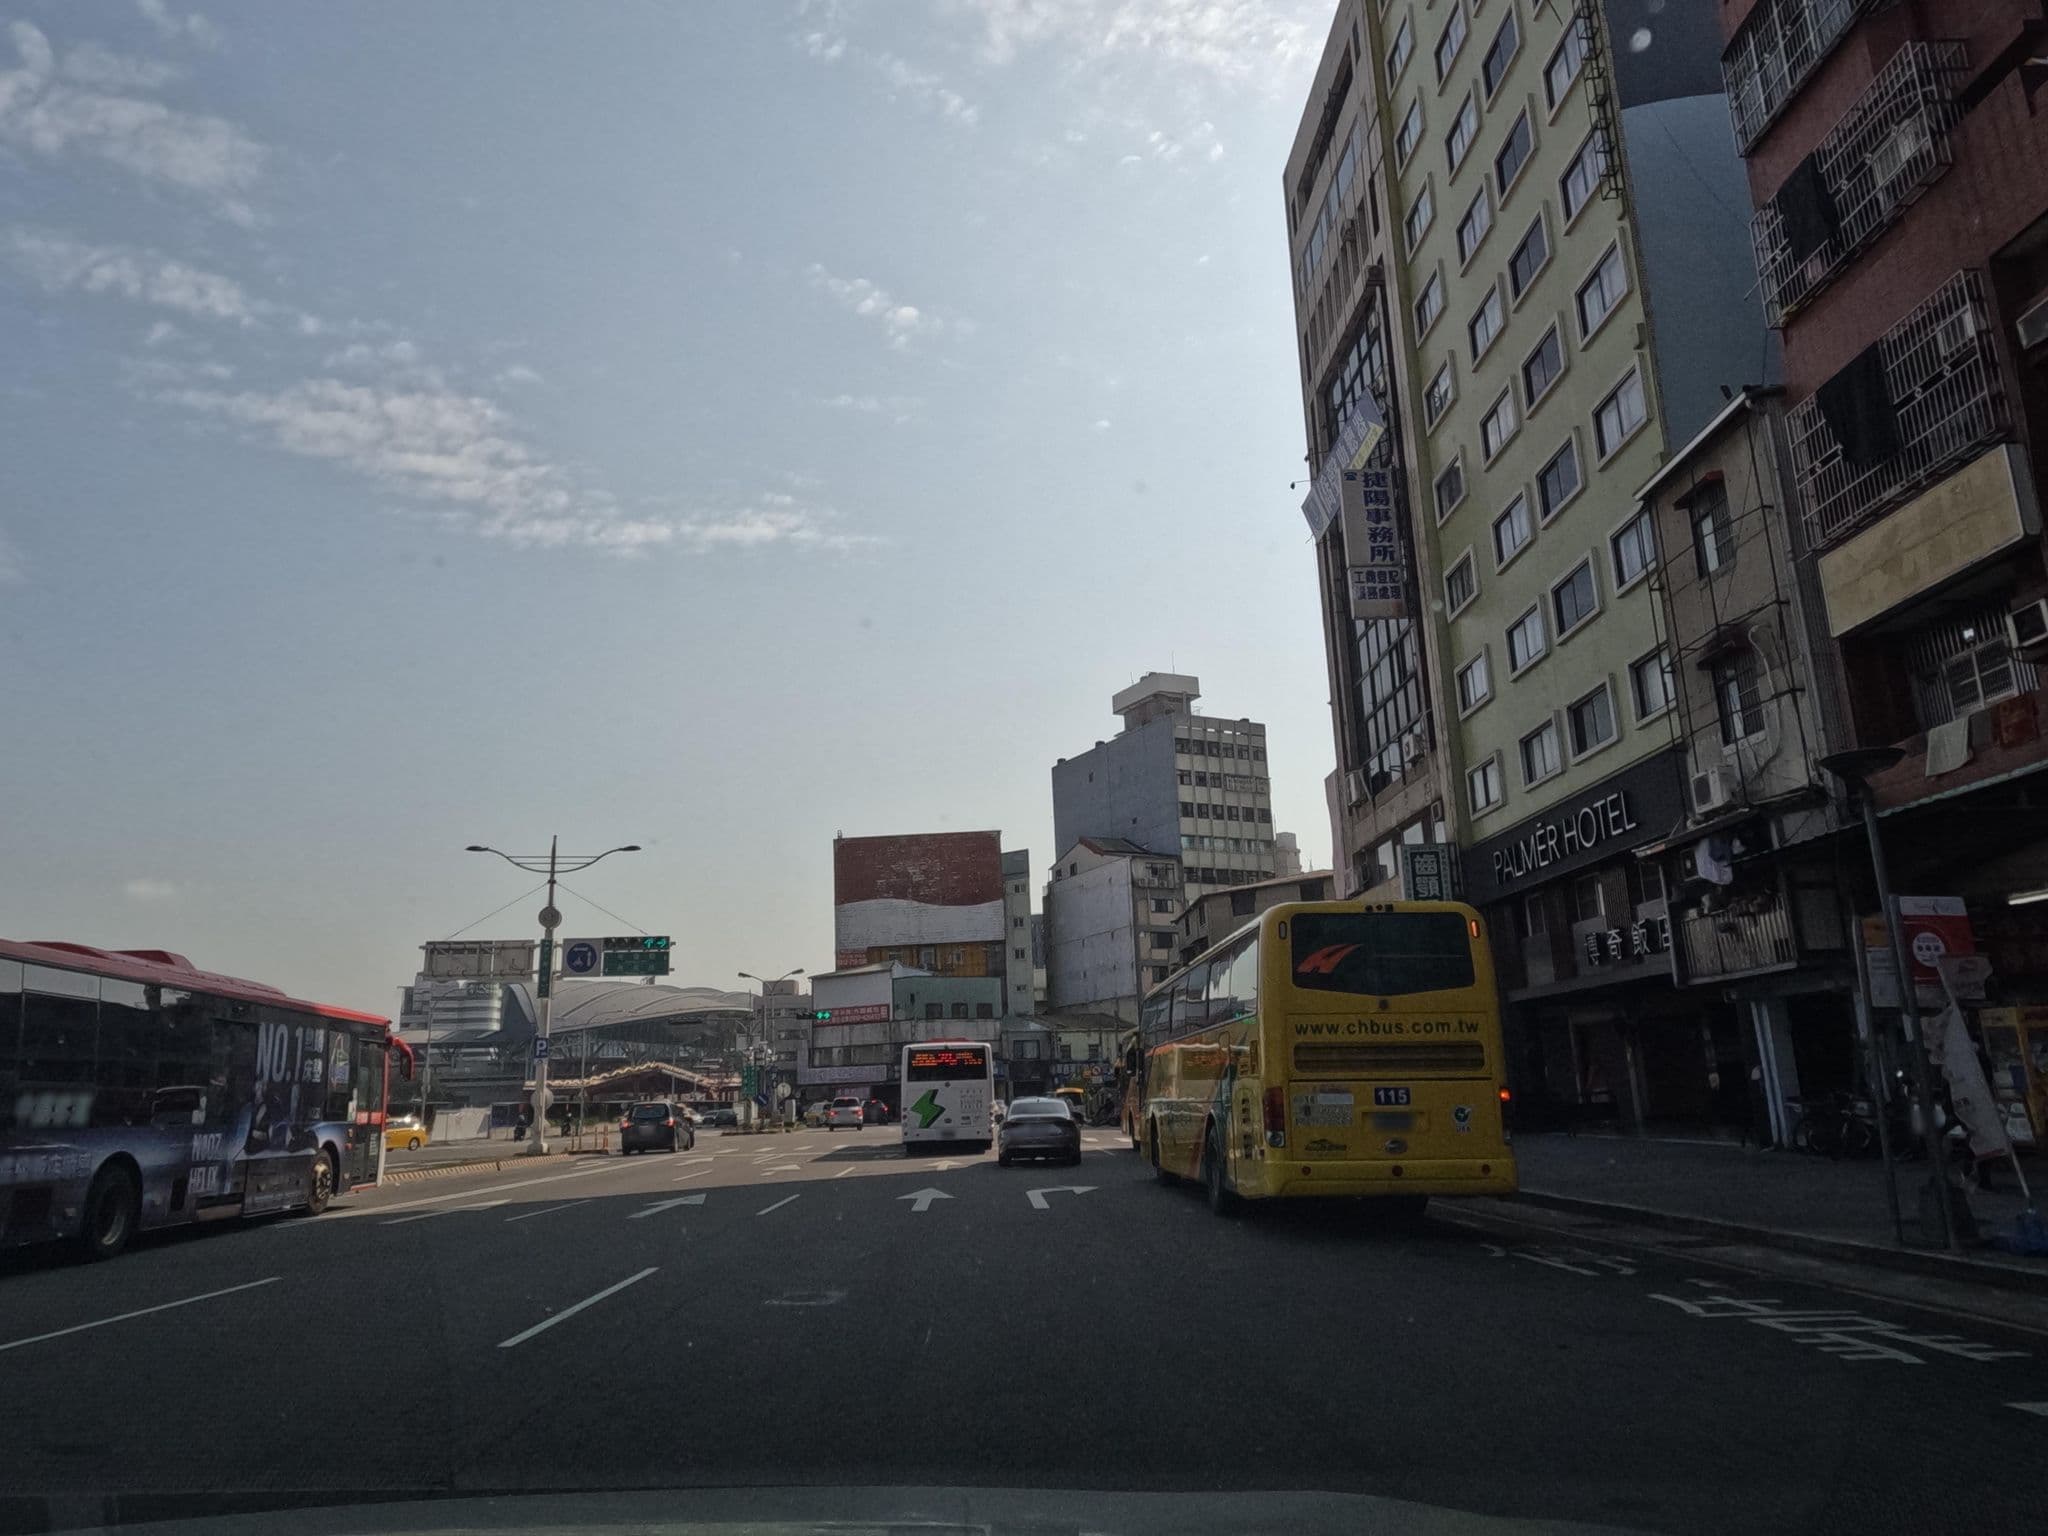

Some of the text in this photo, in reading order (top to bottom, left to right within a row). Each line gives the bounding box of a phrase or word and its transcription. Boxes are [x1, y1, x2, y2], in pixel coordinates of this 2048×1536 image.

[1562, 790, 1637, 856] HOTEL
[1295, 1019, 1479, 1035] www.chbus.com.tw
[256, 1023, 303, 1083] NO.1
[537, 1040, 547, 1056] P
[1377, 1089, 1408, 1104] 115
